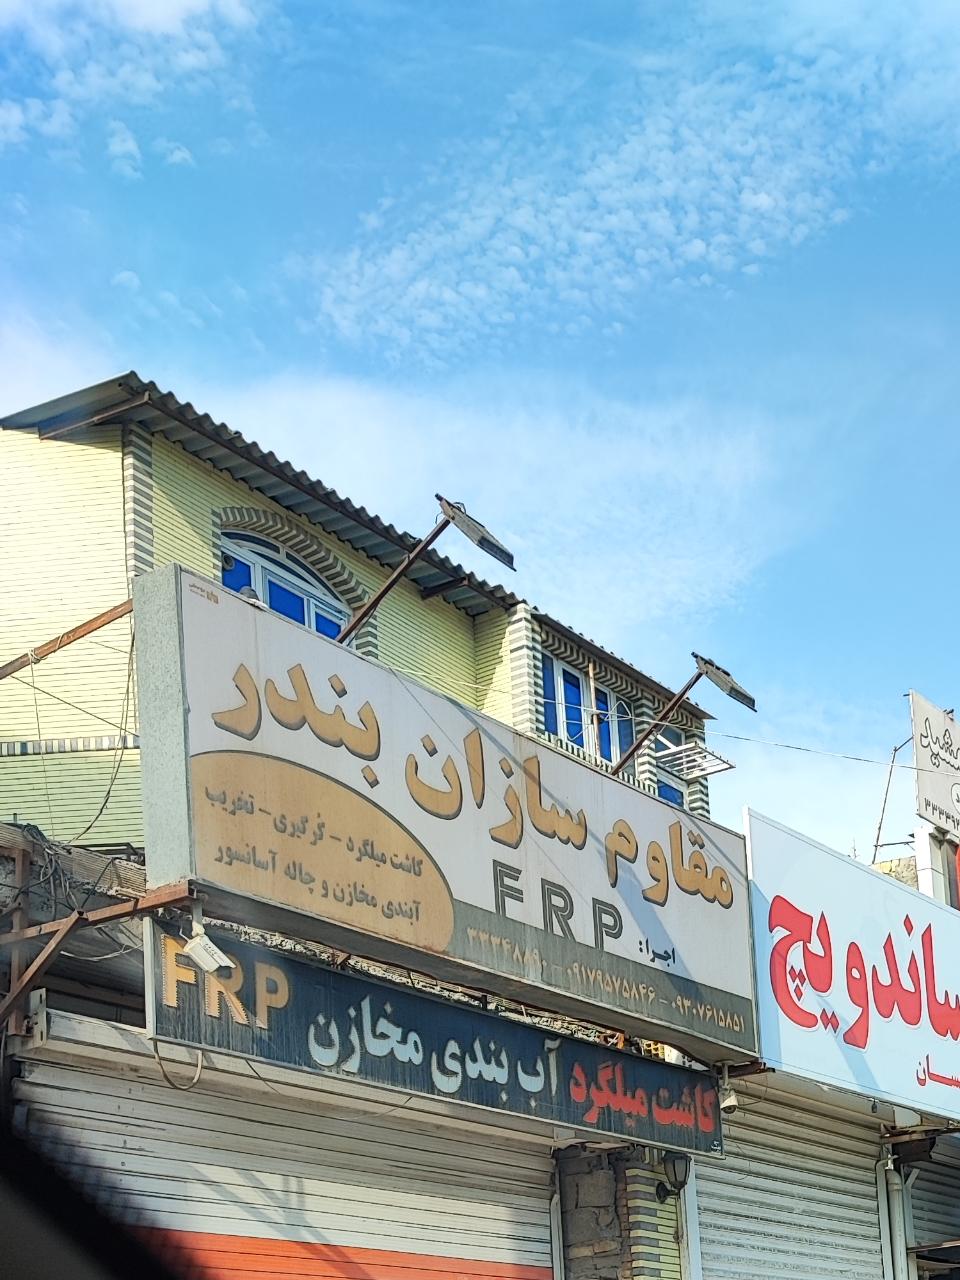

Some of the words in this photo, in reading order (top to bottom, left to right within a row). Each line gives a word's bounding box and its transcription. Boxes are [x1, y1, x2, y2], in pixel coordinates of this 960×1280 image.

[212, 662, 382, 788] بندر
[205, 786, 255, 816] تخریب
[405, 727, 588, 850] سازان
[214, 843, 278, 874] آسانسور
[284, 860, 315, 894] چاله
[346, 835, 387, 868] میلگرد
[605, 818, 735, 910] مقاوم
[321, 879, 329, 898] و
[333, 881, 378, 908] مخازن
[381, 899, 421, 926] آبندی
[491, 859, 624, 951] FRP
[161, 933, 290, 1030] FRP
[308, 994, 424, 1074] مخازن
[431, 1036, 509, 1102] بندی
[517, 1037, 562, 1110] آب
[569, 1061, 648, 1128] میلگرد
[652, 1082, 717, 1133] کاشت
